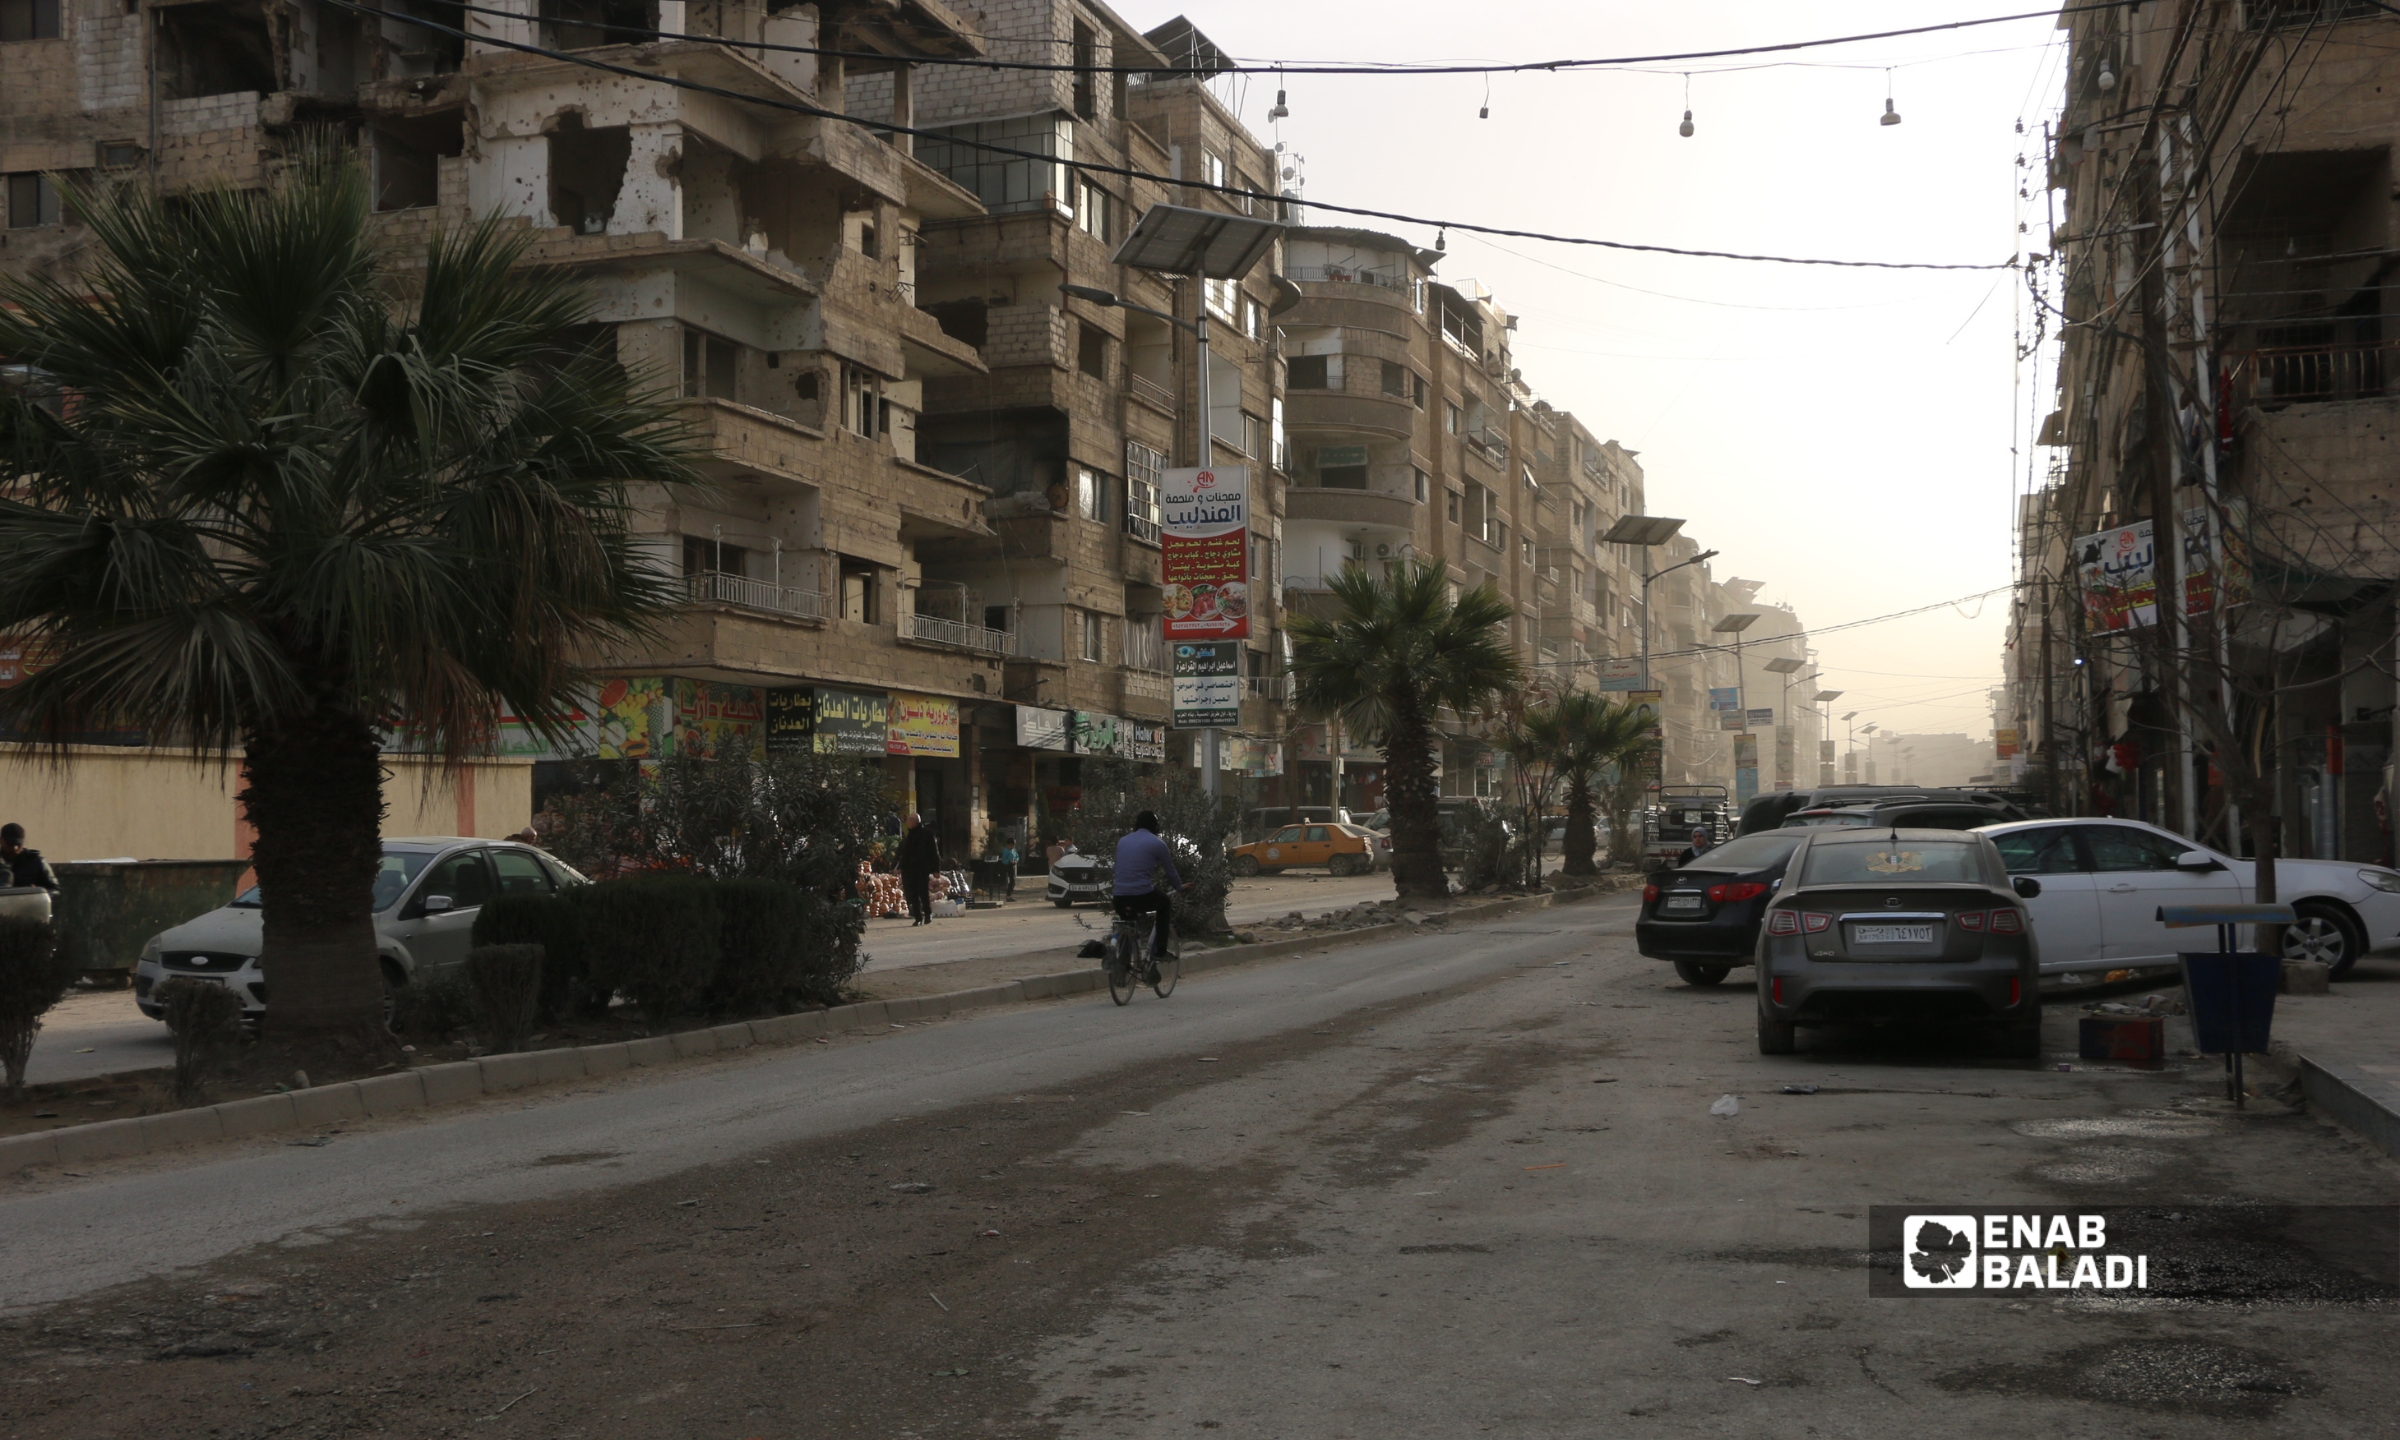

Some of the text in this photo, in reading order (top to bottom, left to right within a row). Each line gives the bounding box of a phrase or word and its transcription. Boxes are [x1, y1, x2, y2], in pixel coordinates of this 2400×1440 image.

[1166, 493, 1241, 505] معجنات و ملحمة
[1166, 505, 1241, 529] العندليب
[1167, 541, 1184, 549] عجل
[1207, 538, 1223, 547] غنم
[1225, 538, 1240, 547] لحم
[1167, 548, 1241, 560] مشاوي دجاج كباب دجاج
[1169, 560, 1240, 571] كبة مشوية بيتزا
[1193, 573, 1216, 581] معجنات
[1198, 661, 1216, 672] ابراهيم
[1216, 660, 1235, 671] اسماعيل
[770, 692, 811, 711] بطاريات
[815, 693, 886, 730] بطاريات العدنان
[771, 715, 809, 734] العدنان
[1660, 848, 1684, 856] SUZU
